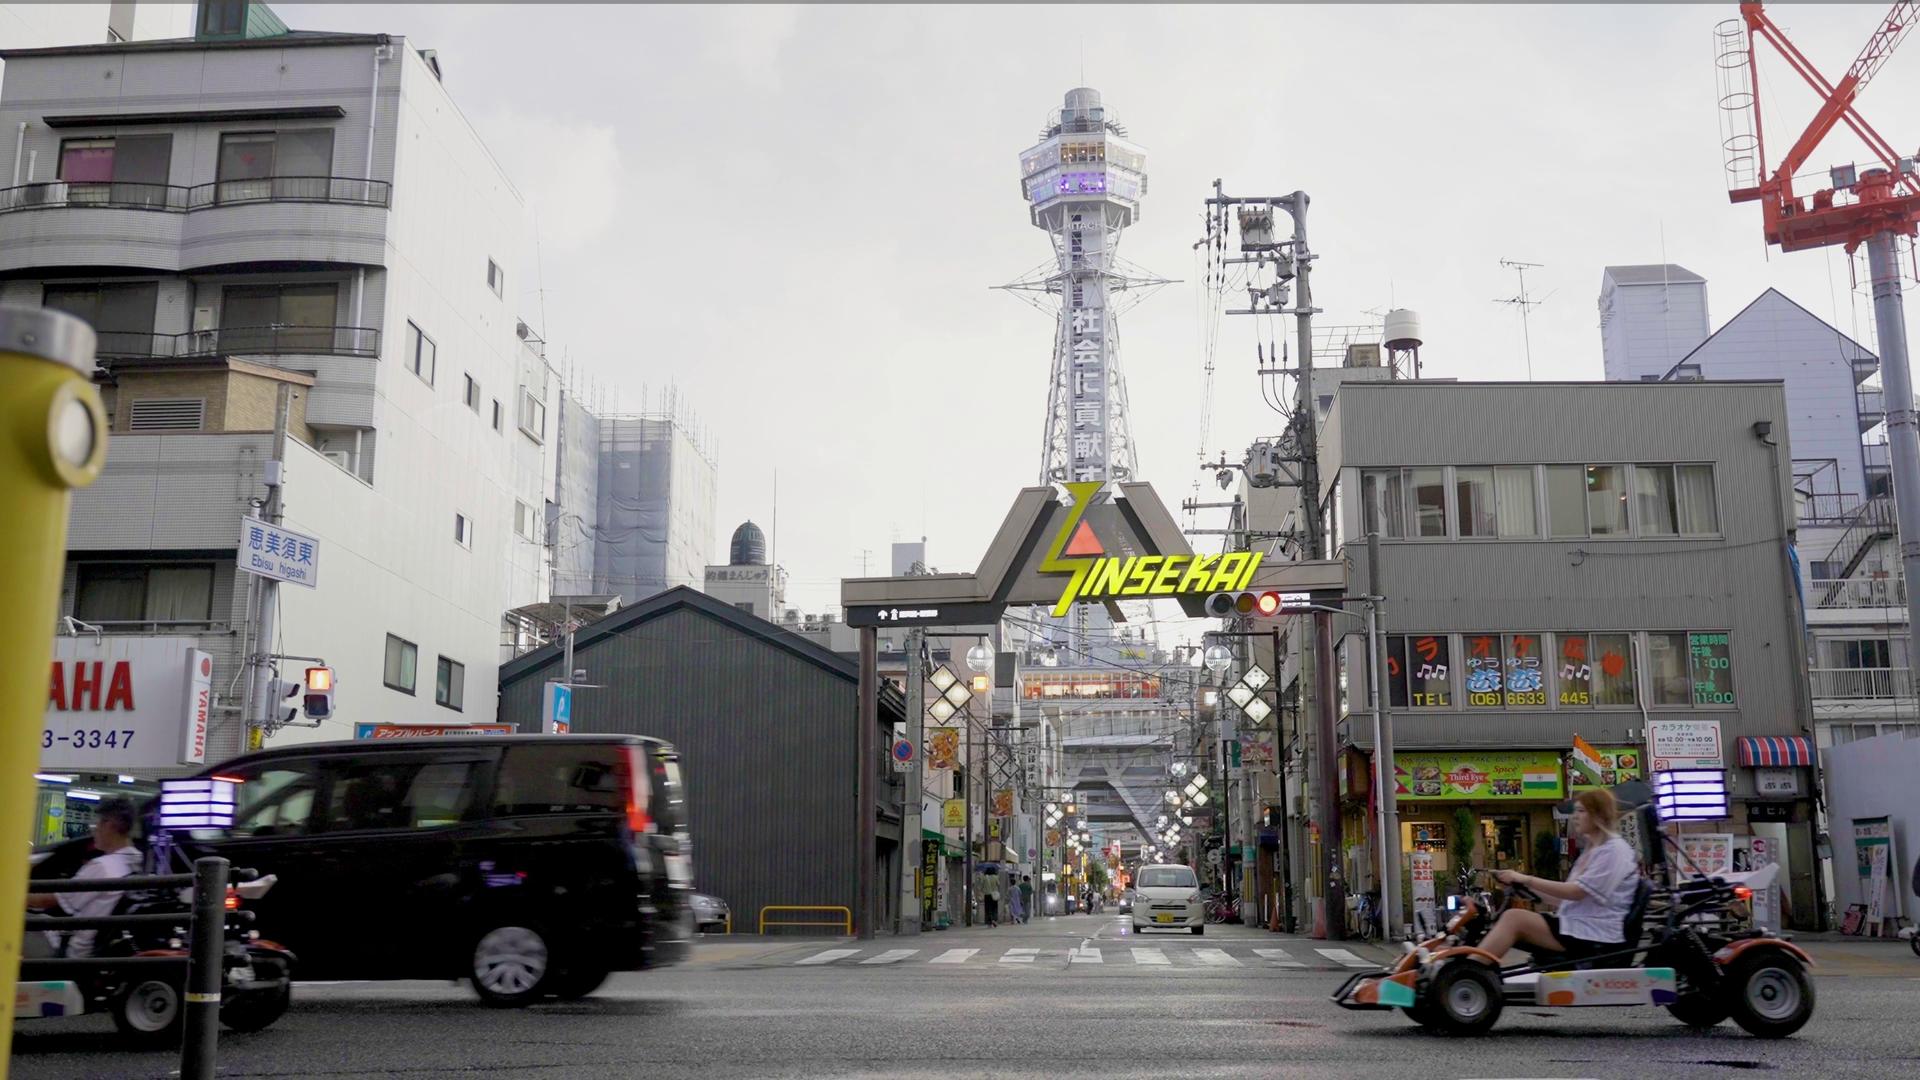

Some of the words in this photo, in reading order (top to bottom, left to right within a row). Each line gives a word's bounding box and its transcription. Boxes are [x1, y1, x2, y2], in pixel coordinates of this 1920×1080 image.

[248, 526, 312, 566] 恵美須東
[1037, 481, 1263, 617] SINSEKAI
[251, 553, 274, 571] Ebisu
[279, 561, 306, 580] higashi
[1694, 658, 1729, 669] 1:00
[1413, 693, 1448, 706] TEL
[1470, 692, 1501, 706] (06)
[1507, 692, 1545, 705] 6633
[1695, 692, 1733, 704] 11:00
[194, 690, 208, 758] YAMAHA
[1449, 773, 1469, 782] Third
